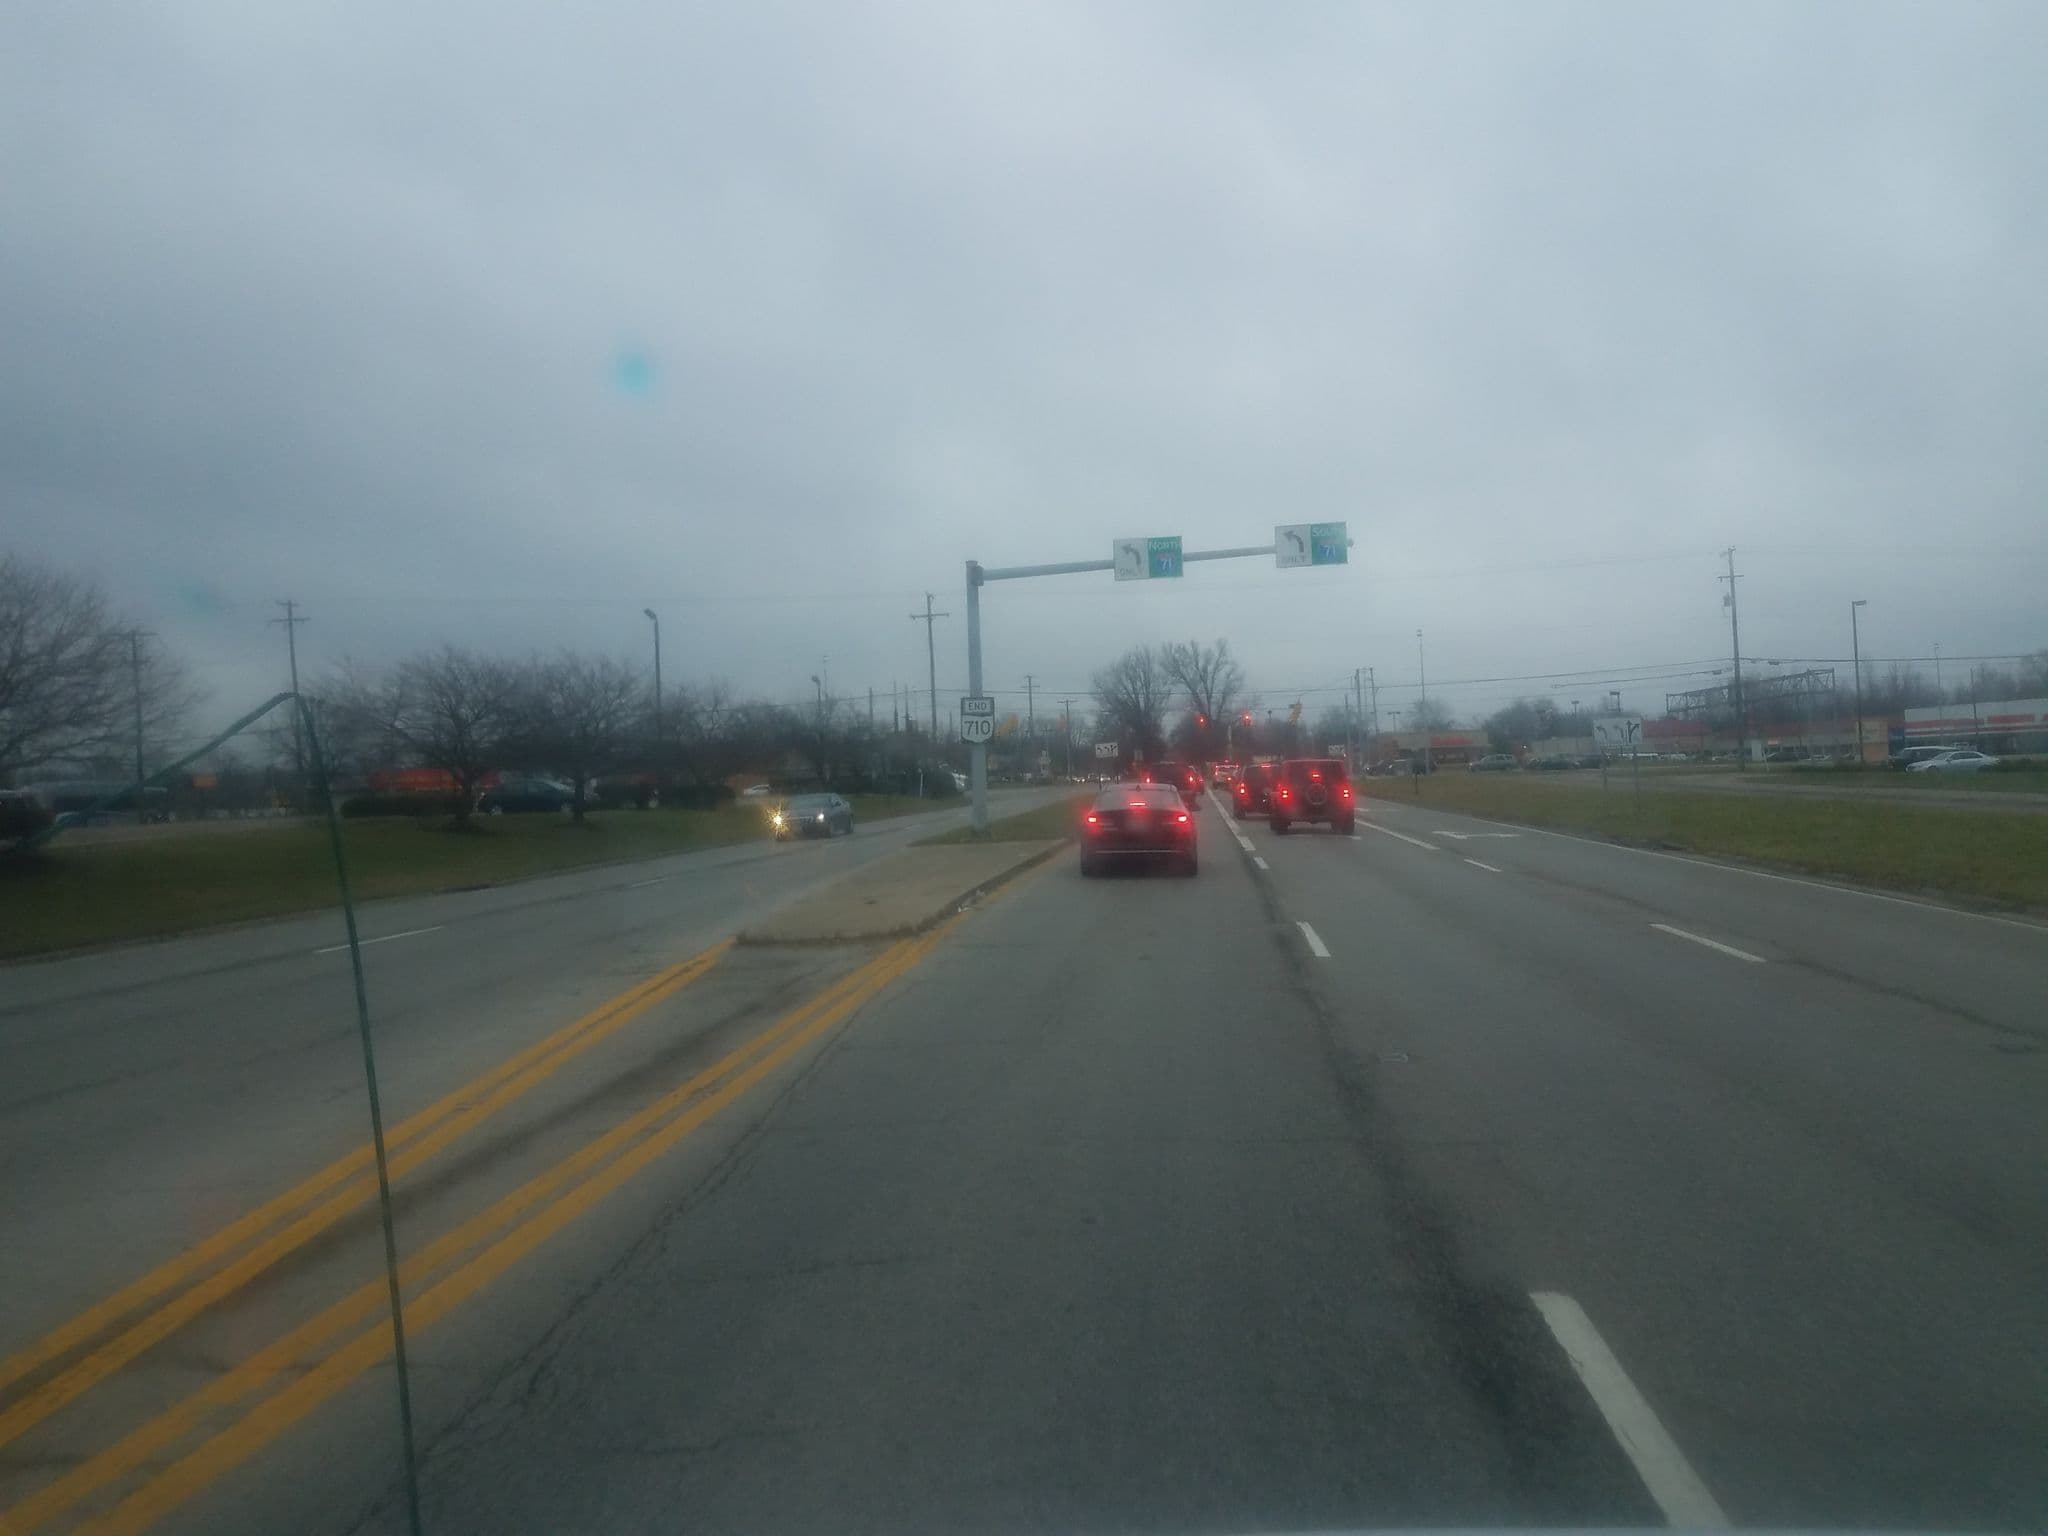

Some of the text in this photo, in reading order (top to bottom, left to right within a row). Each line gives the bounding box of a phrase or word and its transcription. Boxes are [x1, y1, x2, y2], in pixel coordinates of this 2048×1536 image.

[1149, 541, 1179, 551] NORTH
[1321, 544, 1336, 558] 71
[1160, 557, 1172, 570] 71
[969, 702, 987, 711] END
[964, 720, 990, 736] 710
